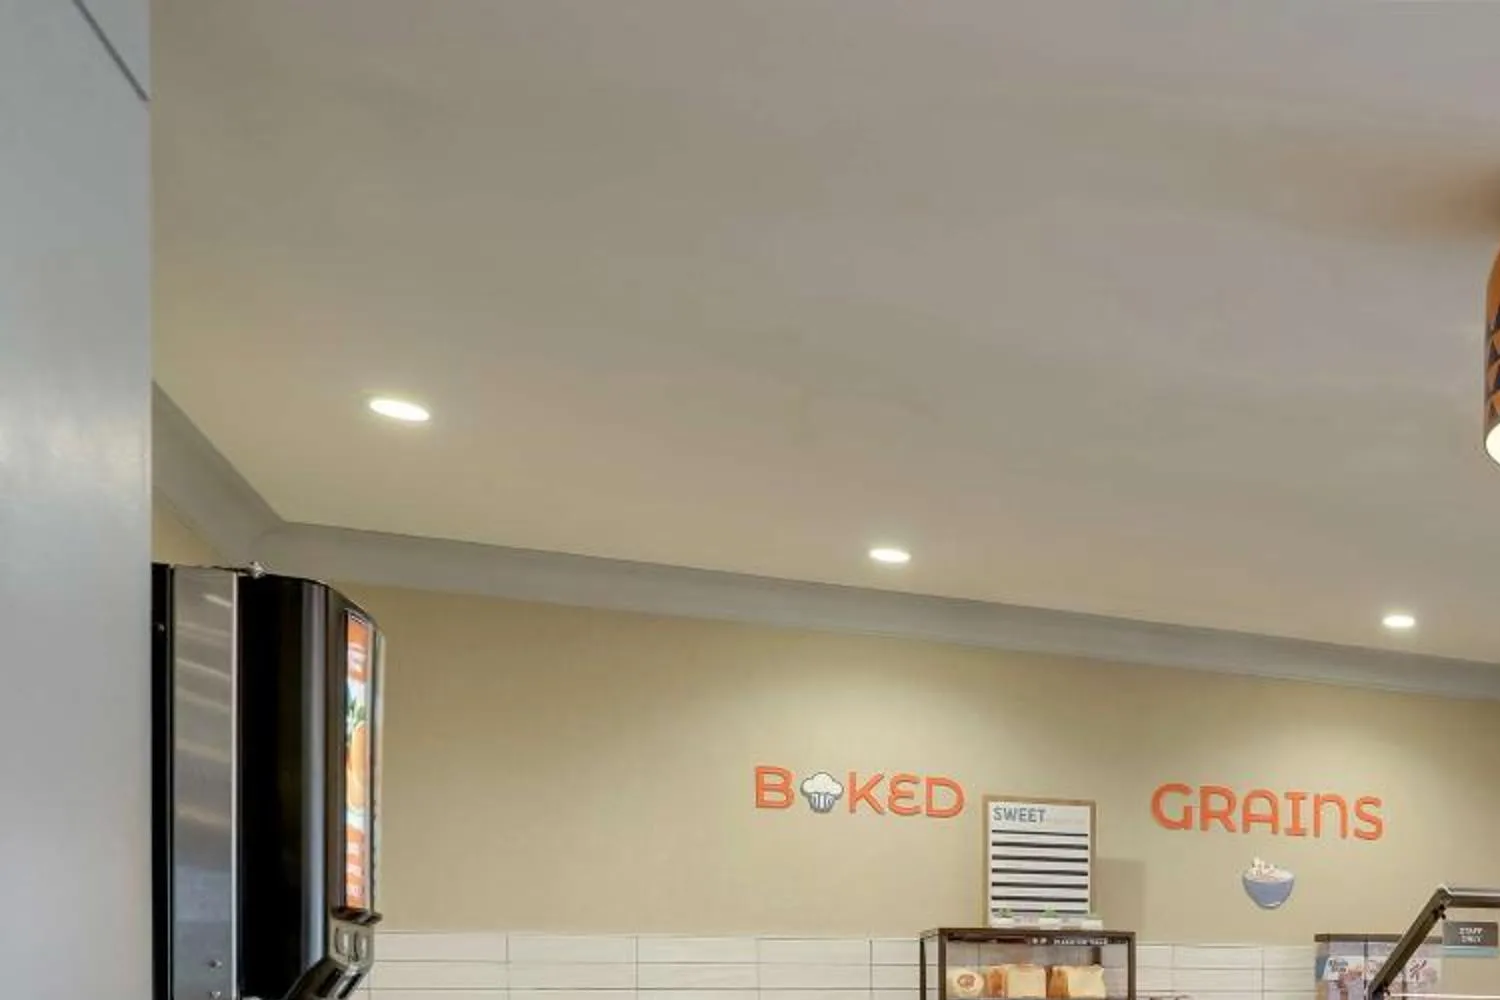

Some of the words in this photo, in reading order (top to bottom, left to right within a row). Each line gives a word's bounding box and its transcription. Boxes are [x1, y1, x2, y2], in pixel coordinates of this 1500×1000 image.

[755, 766, 965, 818] BKED
[993, 806, 1046, 823] SWEET
[1151, 782, 1384, 841] GRAINS
